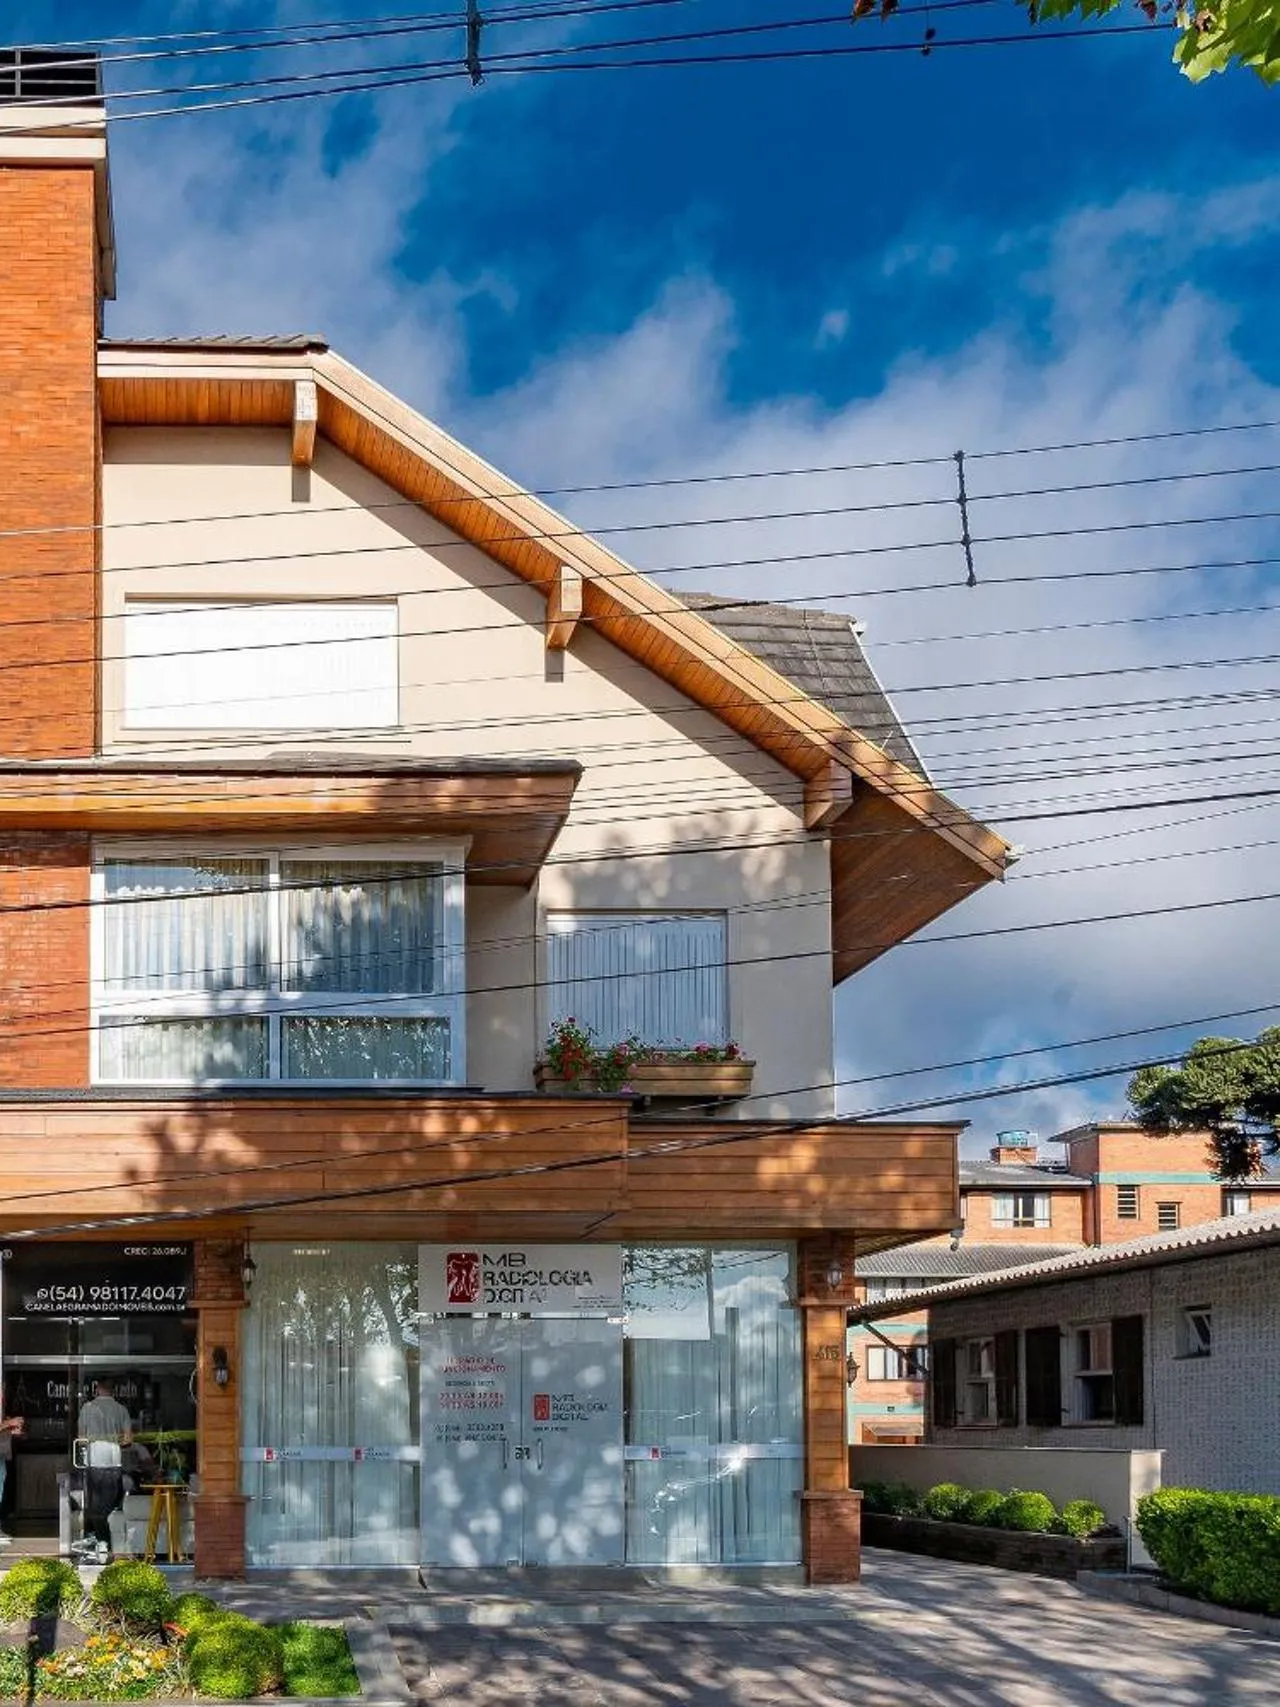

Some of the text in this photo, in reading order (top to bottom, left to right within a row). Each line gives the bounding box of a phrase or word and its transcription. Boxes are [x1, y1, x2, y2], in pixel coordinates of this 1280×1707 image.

[482, 1252, 526, 1268] MB
[483, 1271, 593, 1287] RADIOLOGIA
[49, 1285, 187, 1302] (54) 98117.4047
